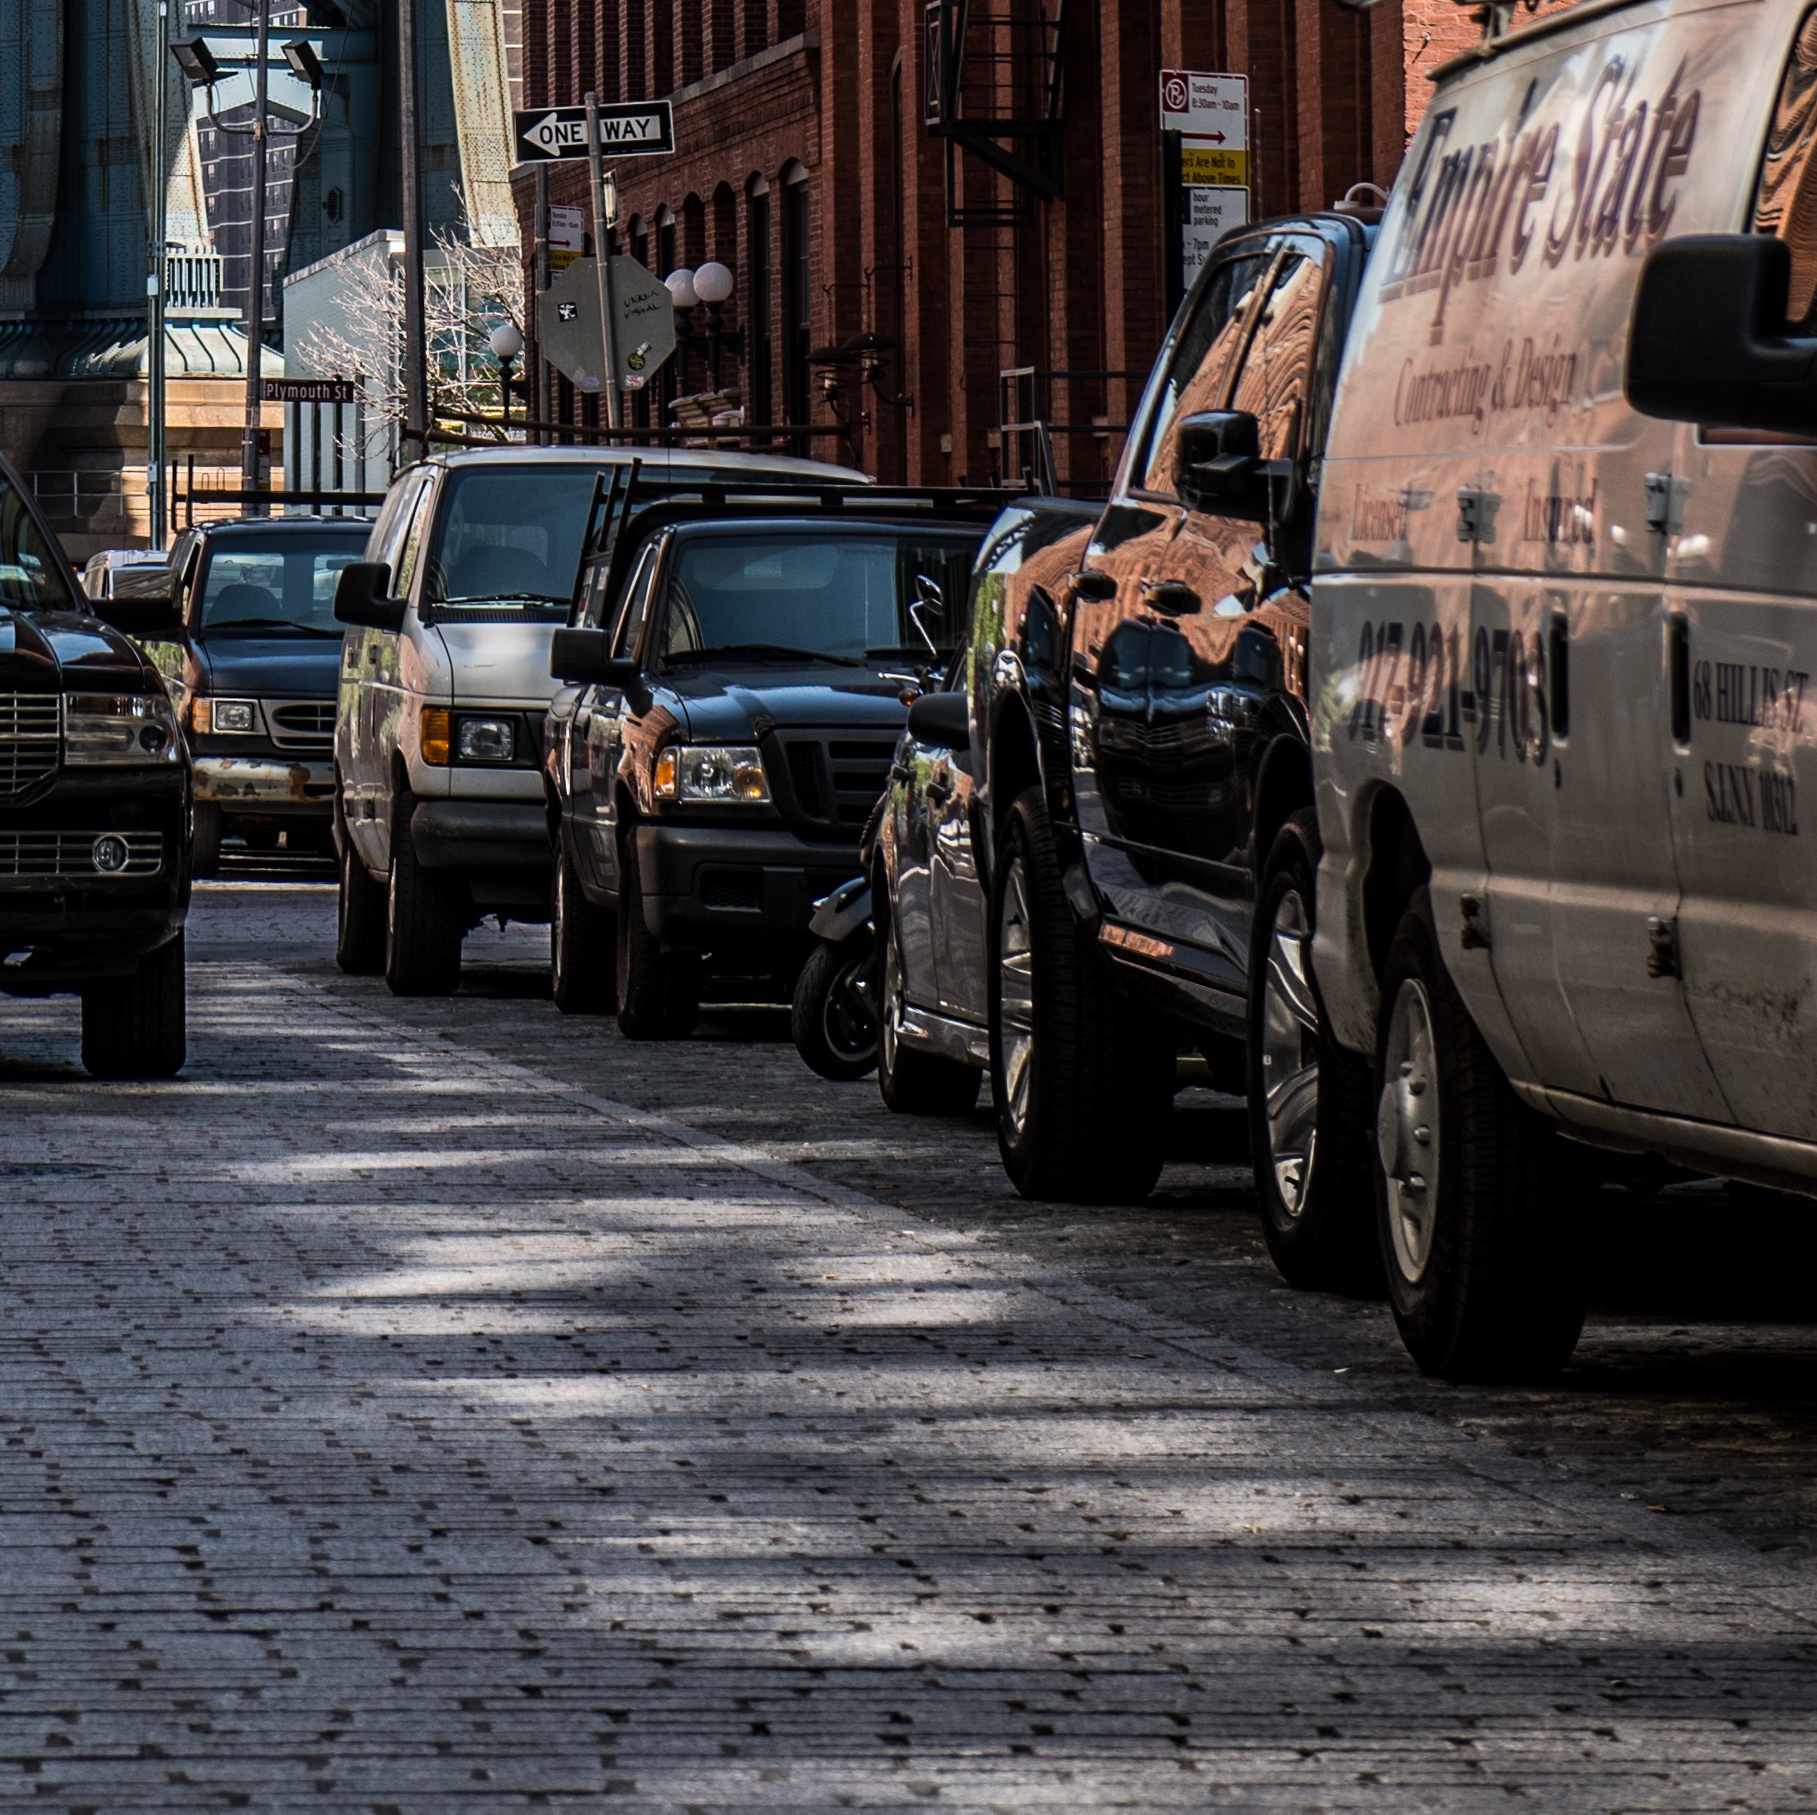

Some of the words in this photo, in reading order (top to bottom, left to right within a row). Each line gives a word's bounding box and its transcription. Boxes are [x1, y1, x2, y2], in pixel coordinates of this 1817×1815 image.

[1191, 82, 1218, 96] Tuesday
[1191, 97, 1217, 109] 8:30am
[1222, 99, 1240, 110] 10am
[539, 123, 584, 145] ONE
[604, 118, 651, 141] WAY
[1196, 155, 1209, 168] Are
[1211, 156, 1225, 169] Not
[1227, 157, 1236, 169] In
[1192, 172, 1217, 184] Above
[1218, 172, 1241, 185] Times
[1193, 192, 1210, 202] hour
[1378, 78, 1560, 345] Empire
[1541, 52, 1701, 269] State
[1193, 204, 1222, 215] metered
[1193, 216, 1219, 228] parking
[1193, 238, 1210, 252] 7pm
[1394, 345, 1491, 435] Contracting
[1512, 333, 1577, 428] Design
[266, 383, 330, 400] Plymouth
[334, 385, 348, 400] St
[1693, 660, 1712, 721] 68
